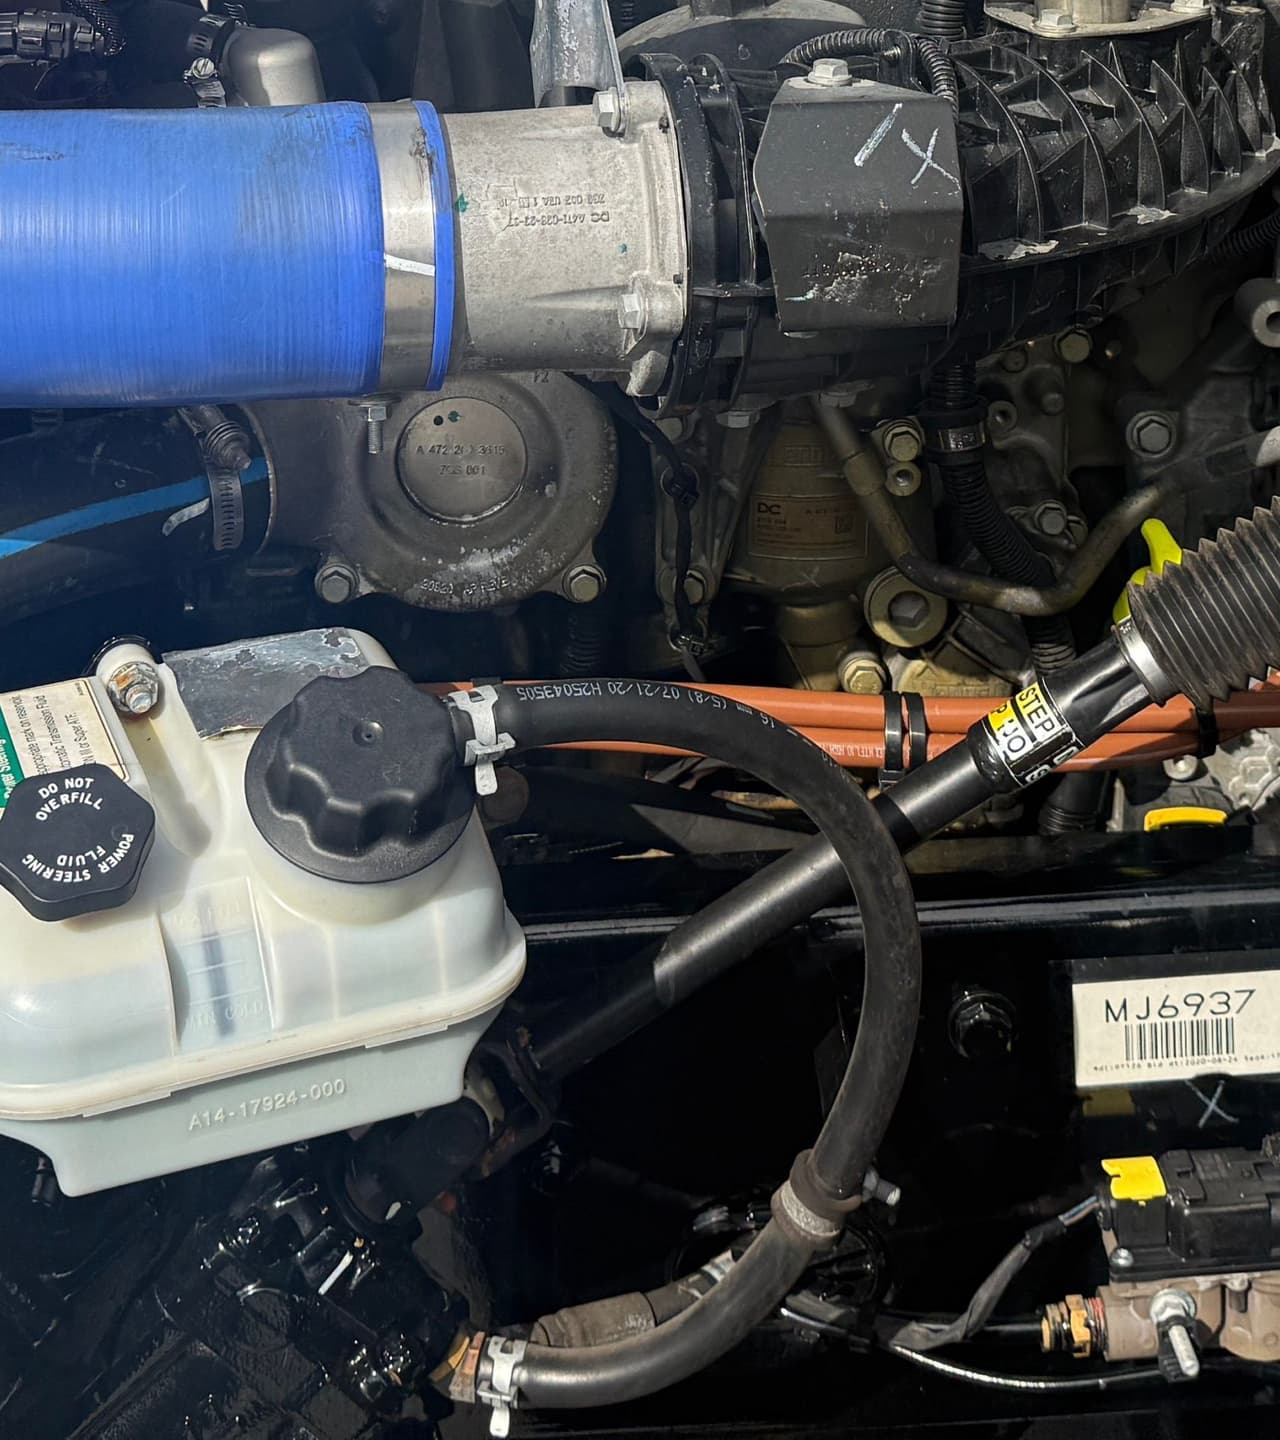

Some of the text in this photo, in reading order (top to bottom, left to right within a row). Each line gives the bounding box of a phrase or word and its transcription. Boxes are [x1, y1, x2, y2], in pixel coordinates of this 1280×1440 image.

[757, 503, 781, 514] DC
[517, 681, 602, 701] H25043505
[608, 681, 680, 699] 07/21/20
[689, 690, 727, 710] (5/8)
[761, 712, 776, 729] 16
[1018, 687, 1056, 734] STEP
[38, 778, 94, 798] DO NOT
[36, 792, 104, 821] OVERFILL
[22, 833, 134, 882] POWER STEERING
[57, 846, 106, 866] FLUID
[1105, 989, 1256, 1023] MJ6937
[188, 1078, 347, 1131] A14-17924-000
